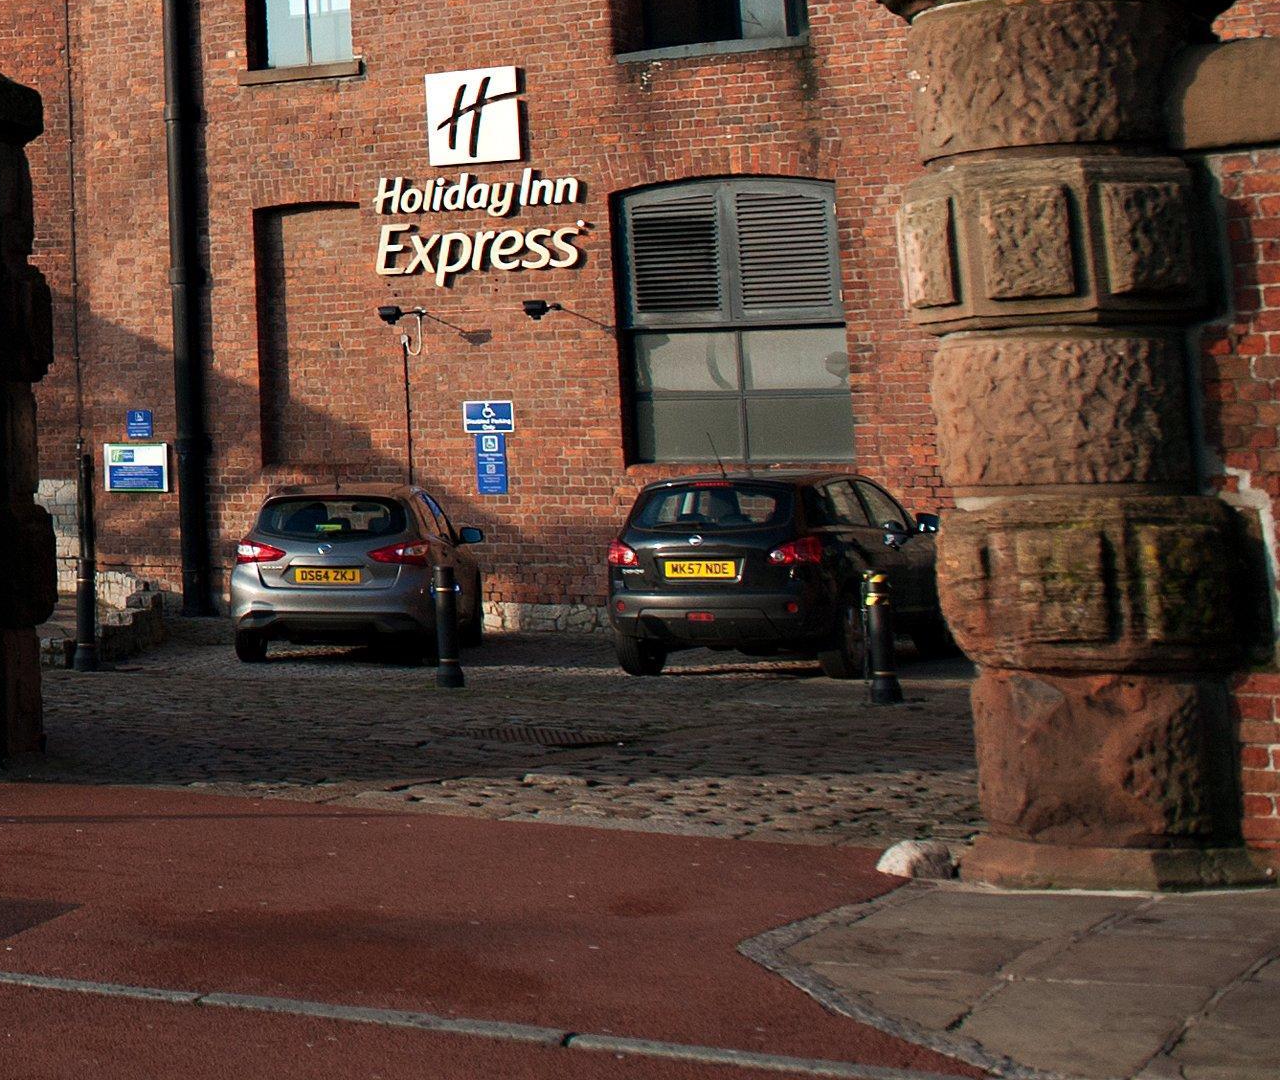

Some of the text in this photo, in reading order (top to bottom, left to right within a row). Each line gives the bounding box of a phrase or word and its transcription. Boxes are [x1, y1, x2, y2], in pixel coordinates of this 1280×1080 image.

[372, 167, 579, 217] Holiday Inn
[375, 223, 579, 287] Express
[301, 570, 356, 581] DS64 ZKJ
[671, 563, 702, 575] MK57
